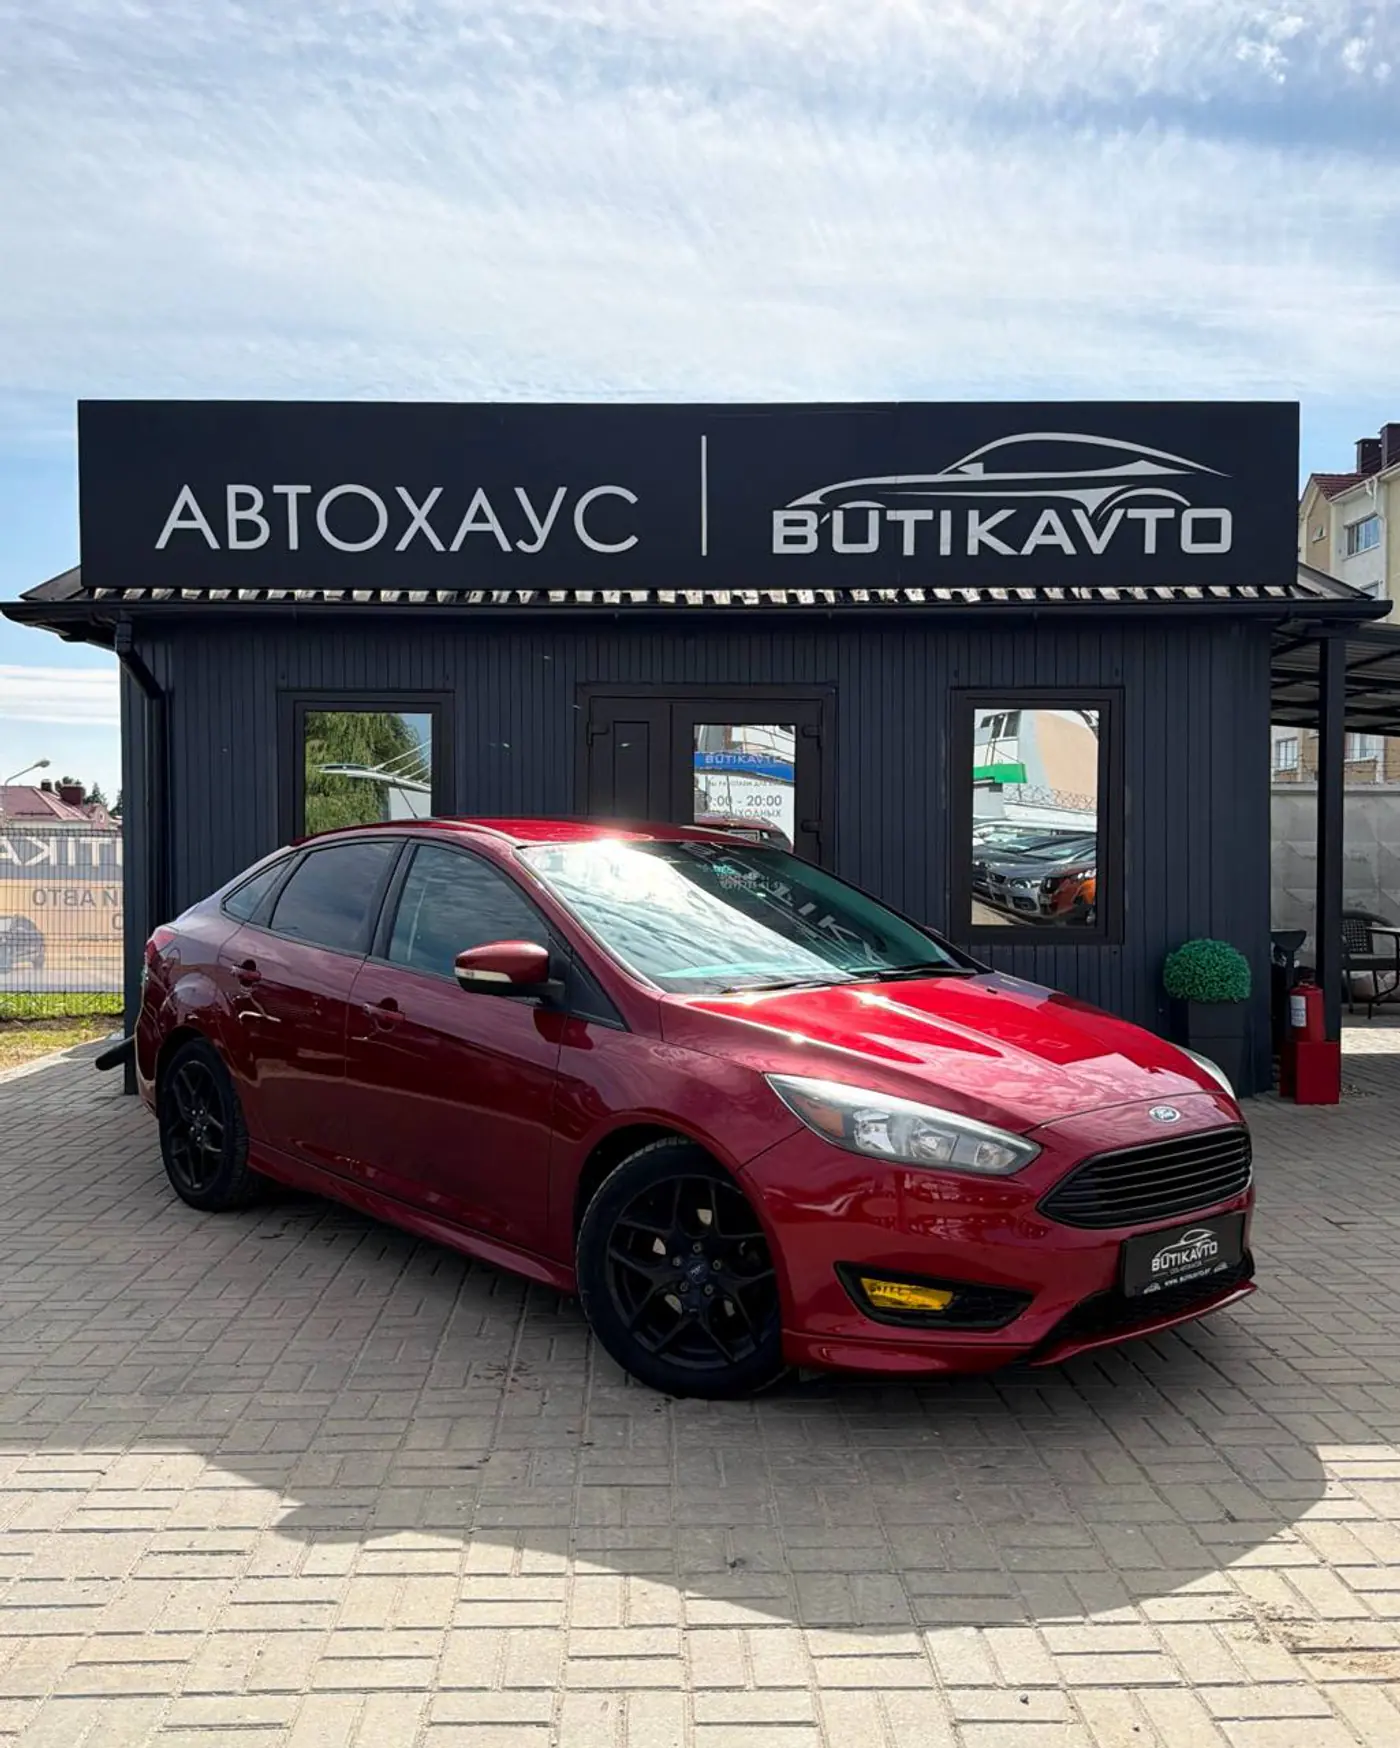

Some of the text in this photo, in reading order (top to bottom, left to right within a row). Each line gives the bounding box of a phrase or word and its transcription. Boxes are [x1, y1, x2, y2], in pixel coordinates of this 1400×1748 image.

[154, 483, 640, 554] АВТОХАУС
[772, 507, 1233, 557] BUTIKAVTO
[746, 795, 782, 806] 20:00
[1151, 1241, 1218, 1272] BUTIKAVTO
